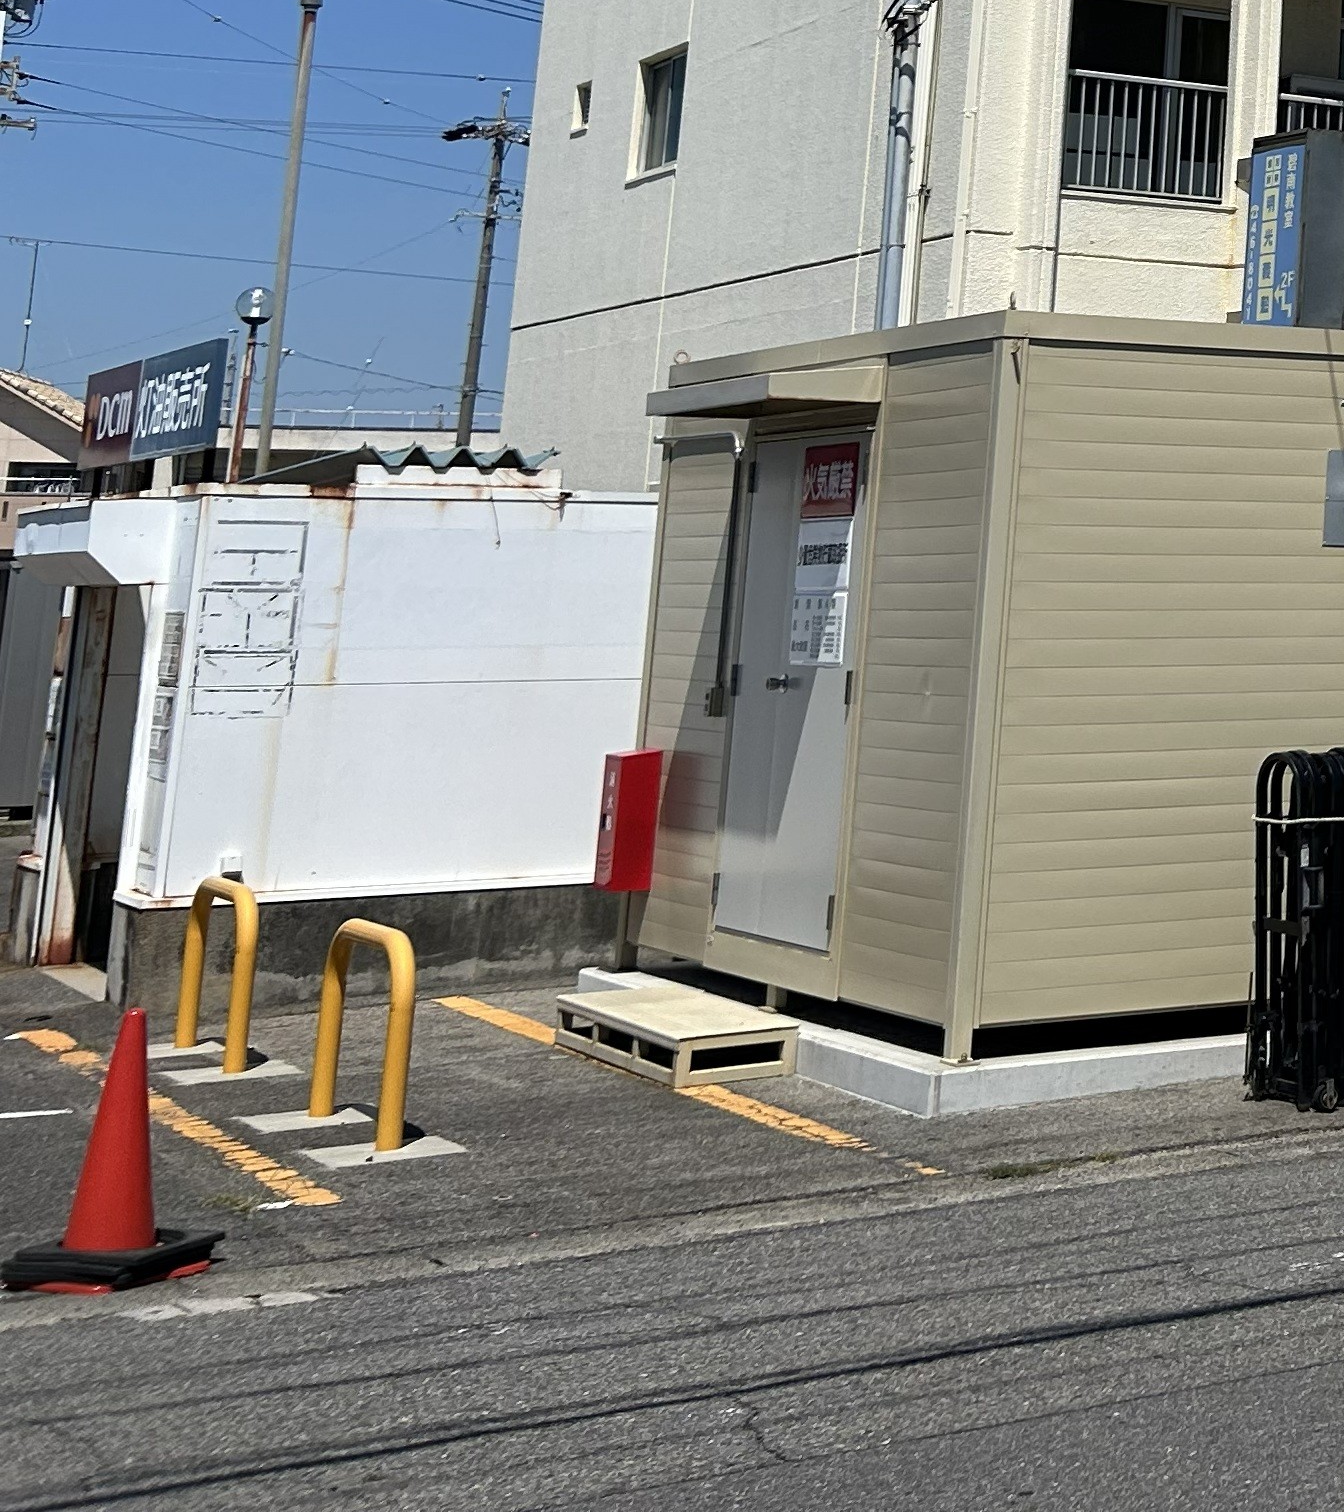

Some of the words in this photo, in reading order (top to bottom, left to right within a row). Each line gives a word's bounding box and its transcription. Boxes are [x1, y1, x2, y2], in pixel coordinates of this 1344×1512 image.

[1280, 270, 1296, 288] 2F
[135, 362, 211, 439] 灯油販売所
